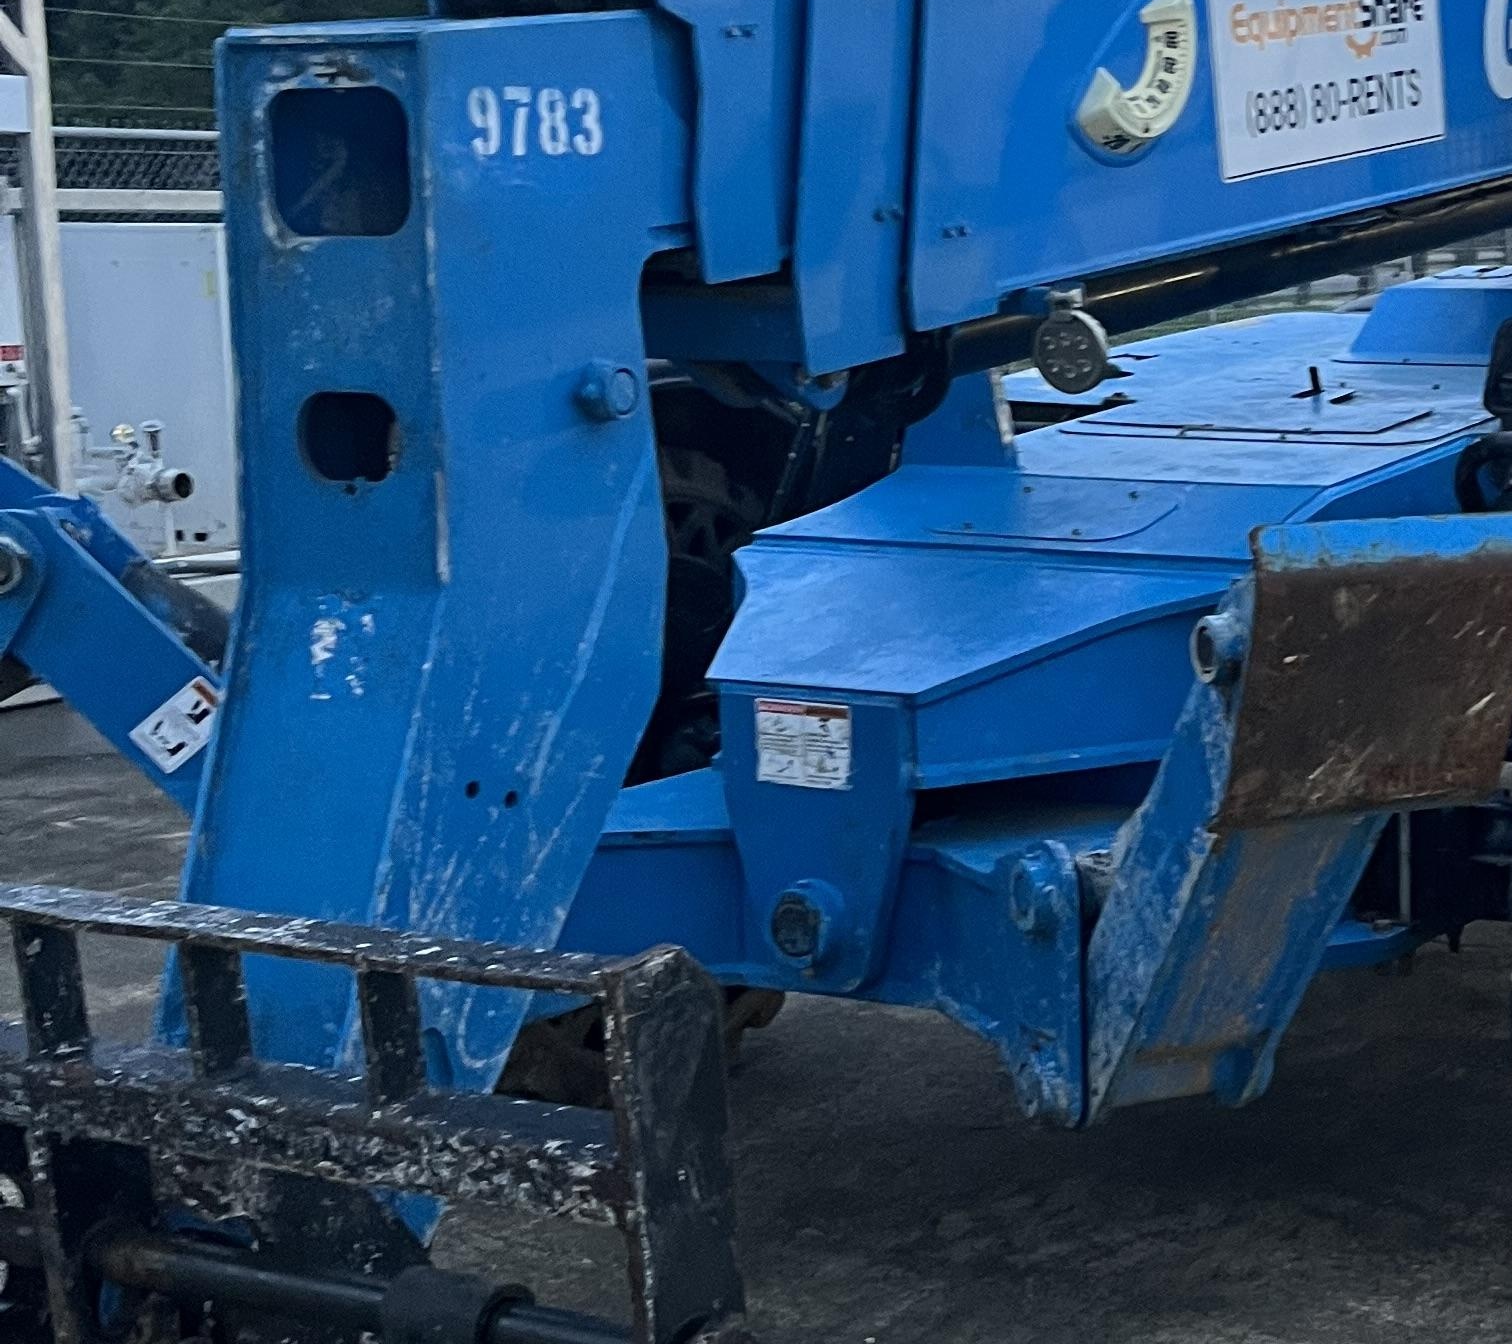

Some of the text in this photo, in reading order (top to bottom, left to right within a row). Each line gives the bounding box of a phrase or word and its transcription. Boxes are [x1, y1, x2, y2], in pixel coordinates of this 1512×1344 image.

[468, 85, 603, 157] 9783
[1246, 68, 1422, 138] (888) 80-RENTS
